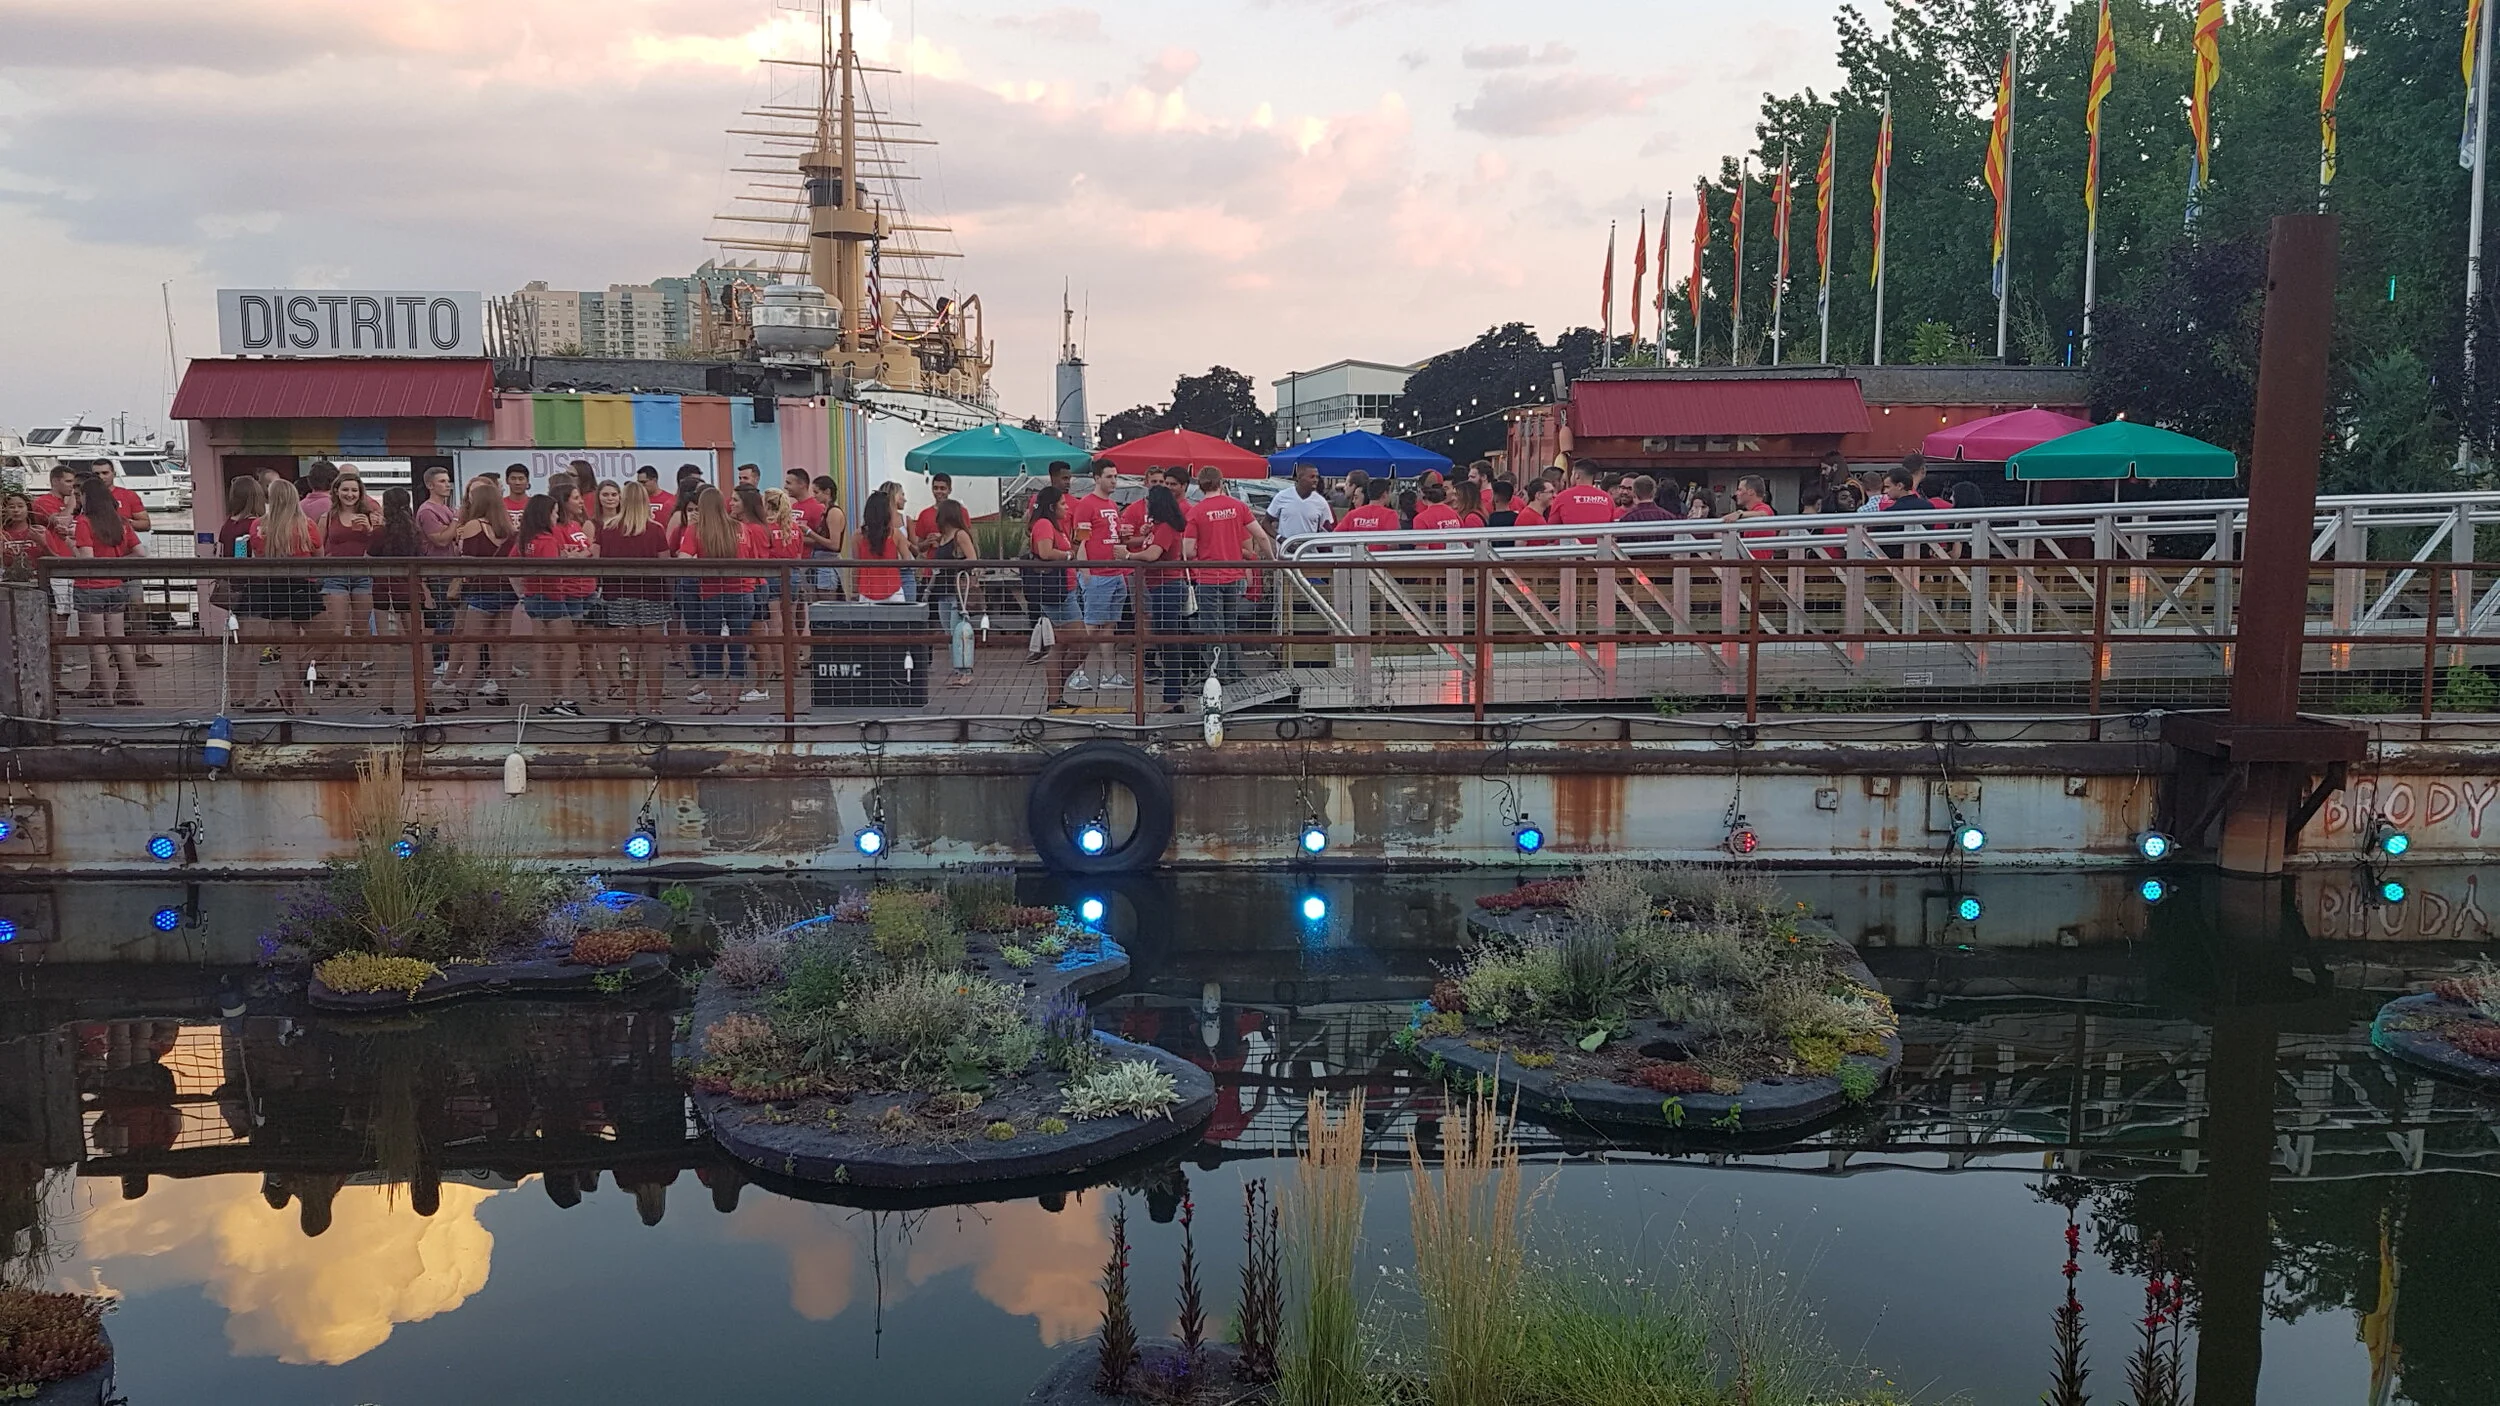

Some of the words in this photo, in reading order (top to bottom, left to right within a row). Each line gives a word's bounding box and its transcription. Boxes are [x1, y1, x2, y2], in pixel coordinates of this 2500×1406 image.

[240, 295, 460, 350] DISTRITO
[818, 664, 862, 677] DRWC
[2324, 775, 2500, 839] BRODY
